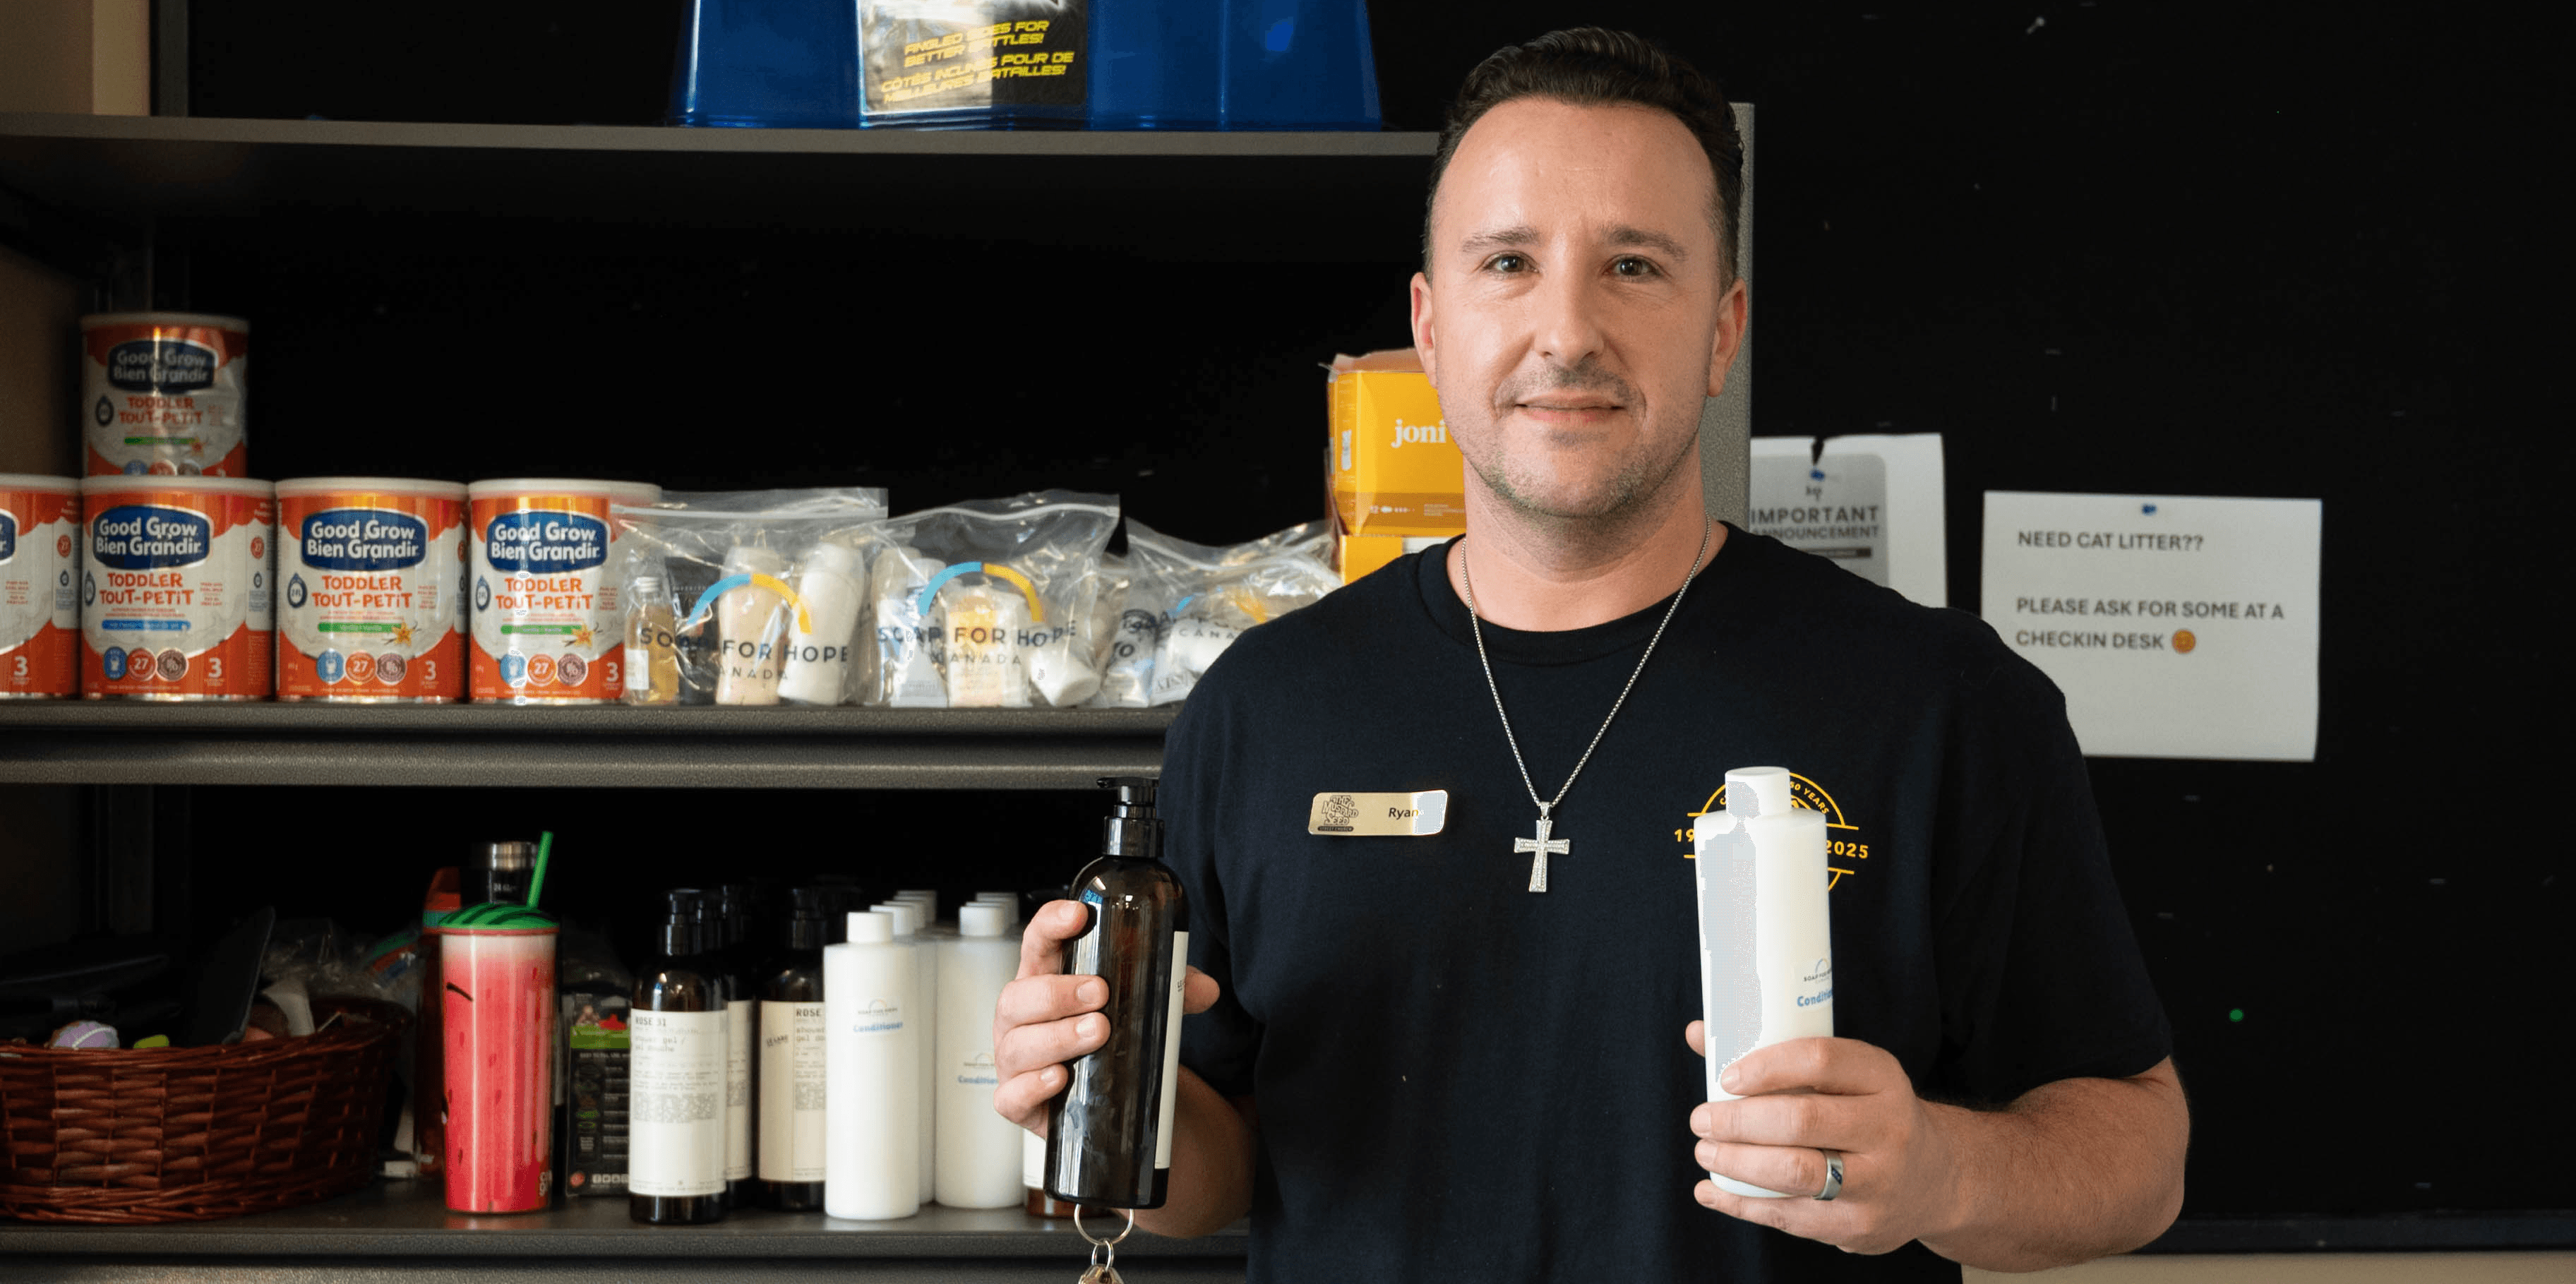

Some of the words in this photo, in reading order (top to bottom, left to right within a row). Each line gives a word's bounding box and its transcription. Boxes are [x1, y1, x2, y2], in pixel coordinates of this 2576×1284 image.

[904, 32, 963, 55] ANGLED
[967, 22, 1012, 41] SIDES
[1015, 20, 1050, 32] FOR
[904, 45, 965, 67] BETTER
[969, 33, 1045, 53] BATTLES!
[1001, 52, 1050, 66] POUR
[1051, 51, 1075, 63] DE
[977, 64, 1067, 83] BATAILLES!
[117, 349, 157, 366] Good
[164, 347, 207, 367] Grow
[113, 365, 146, 381] Bien
[148, 365, 209, 383] Grandir
[127, 396, 196, 409] TODDLER
[1391, 419, 1446, 448] joni
[1751, 505, 1879, 524] IMPORTANT
[99, 516, 142, 536] Good
[145, 516, 198, 536] Grow
[311, 520, 360, 539] Good
[365, 519, 415, 540] Grow
[495, 522, 541, 541] Good
[544, 521, 597, 541] Grow
[95, 536, 126, 554] Bien
[129, 536, 202, 556] Grandir
[306, 538, 345, 558] Bien
[347, 539, 419, 559] Grandir
[2017, 530, 2072, 547] NEED
[2077, 532, 2114, 548] CAT
[2119, 532, 2204, 551] LITTER??
[491, 541, 526, 560] Bien
[529, 541, 601, 561] Grandir
[107, 572, 184, 587] TODDLER
[321, 575, 402, 591] TODDLER
[504, 577, 583, 592] TODDLER
[99, 589, 194, 605] TOUT-PETIT
[311, 592, 413, 608] TOUT-PETIT
[495, 594, 594, 609] TOUT-PETIT
[2015, 597, 2089, 616] PLEASE
[2093, 599, 2133, 617] ASK
[2138, 600, 2177, 618] FOR
[2181, 601, 2239, 619] SOME
[2243, 603, 2267, 619] AT
[2270, 604, 2284, 620] A
[954, 627, 1006, 644] FOR
[1017, 620, 1077, 647] HOPE
[2015, 629, 2107, 649] CHECKIN
[2111, 632, 2164, 650] DESK
[721, 640, 772, 660] FOR
[783, 644, 848, 663] HOPE
[14, 656, 28, 676] 3
[133, 658, 149, 670] 27
[208, 657, 222, 678] 3
[353, 660, 369, 673] 27
[424, 660, 437, 680] 3
[534, 662, 549, 675] 27
[606, 661, 619, 683] 3
[1803, 787, 1830, 815] YEARS
[1388, 807, 1420, 820] Ryan
[1675, 828, 1695, 843] 19
[1826, 839, 1869, 860] 2025
[796, 1008, 822, 1017] ROSE
